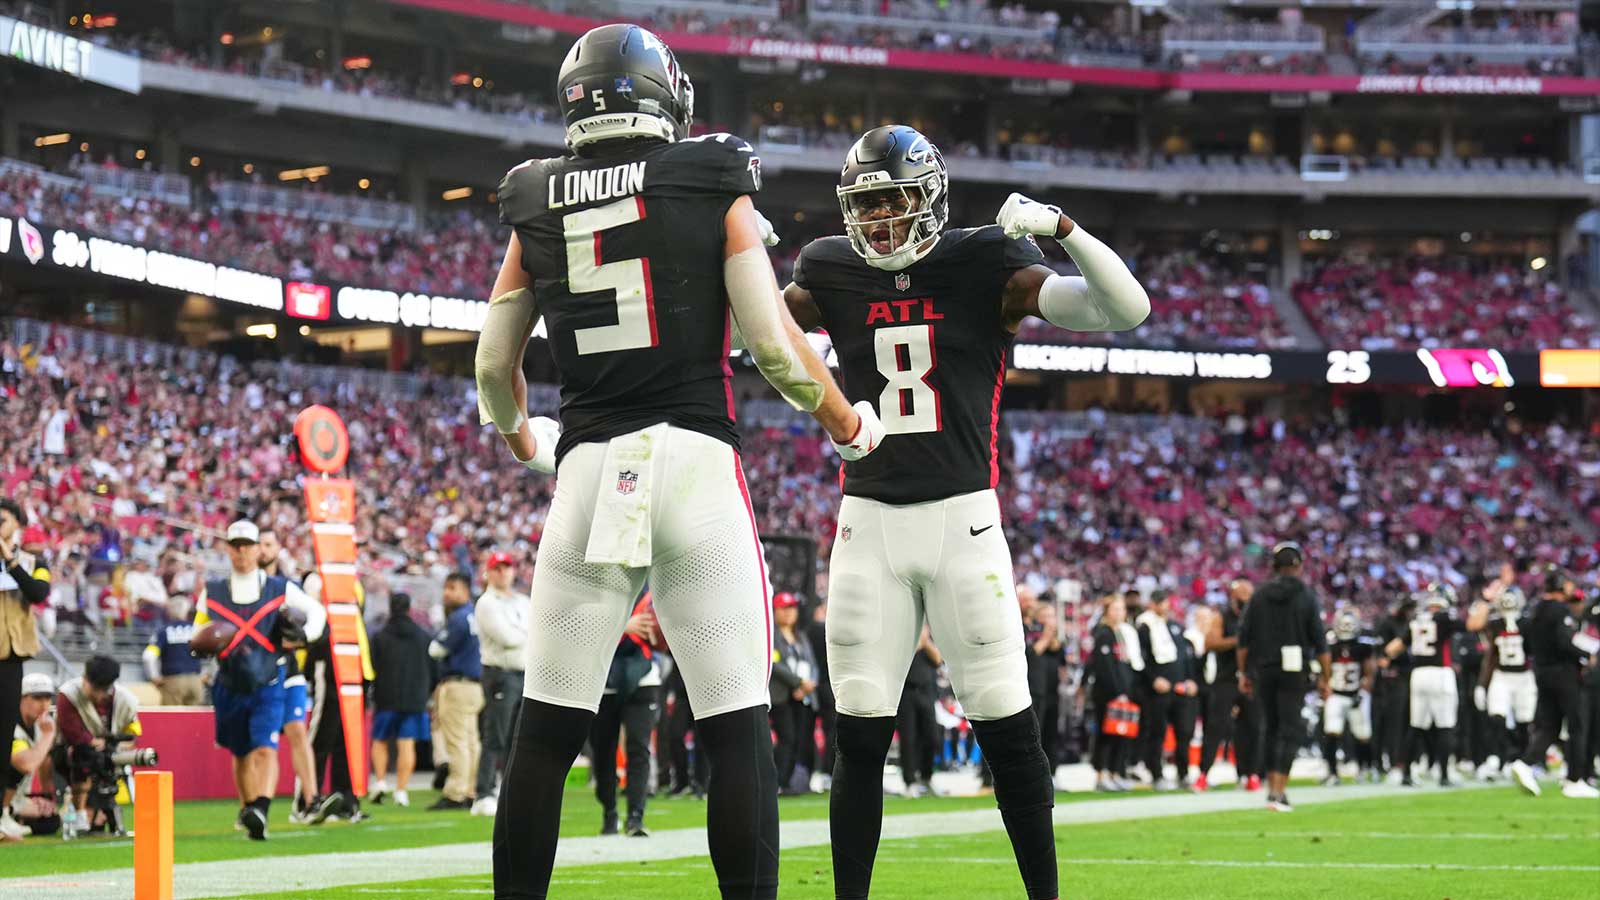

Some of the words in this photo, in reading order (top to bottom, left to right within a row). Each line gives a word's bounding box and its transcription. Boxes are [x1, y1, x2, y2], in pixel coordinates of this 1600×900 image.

[9, 21, 94, 78] AVNET
[750, 39, 817, 60] ADRIAN
[819, 45, 888, 65] WILSON
[1356, 75, 1419, 93] JIMMY
[1421, 75, 1542, 93] CONZELMAN
[592, 89, 606, 112] 5
[583, 117, 627, 128] FALCONS
[548, 161, 647, 209] LONDON
[861, 174, 880, 183] ATL
[563, 195, 659, 356] 5
[865, 297, 945, 326] ATL
[1013, 343, 1107, 372] KICKOFF
[1107, 348, 1195, 377] RETURN
[1195, 352, 1272, 379] YARDS
[1326, 350, 1371, 384] 25
[874, 324, 942, 436] 8
[1409, 620, 1438, 656] 12
